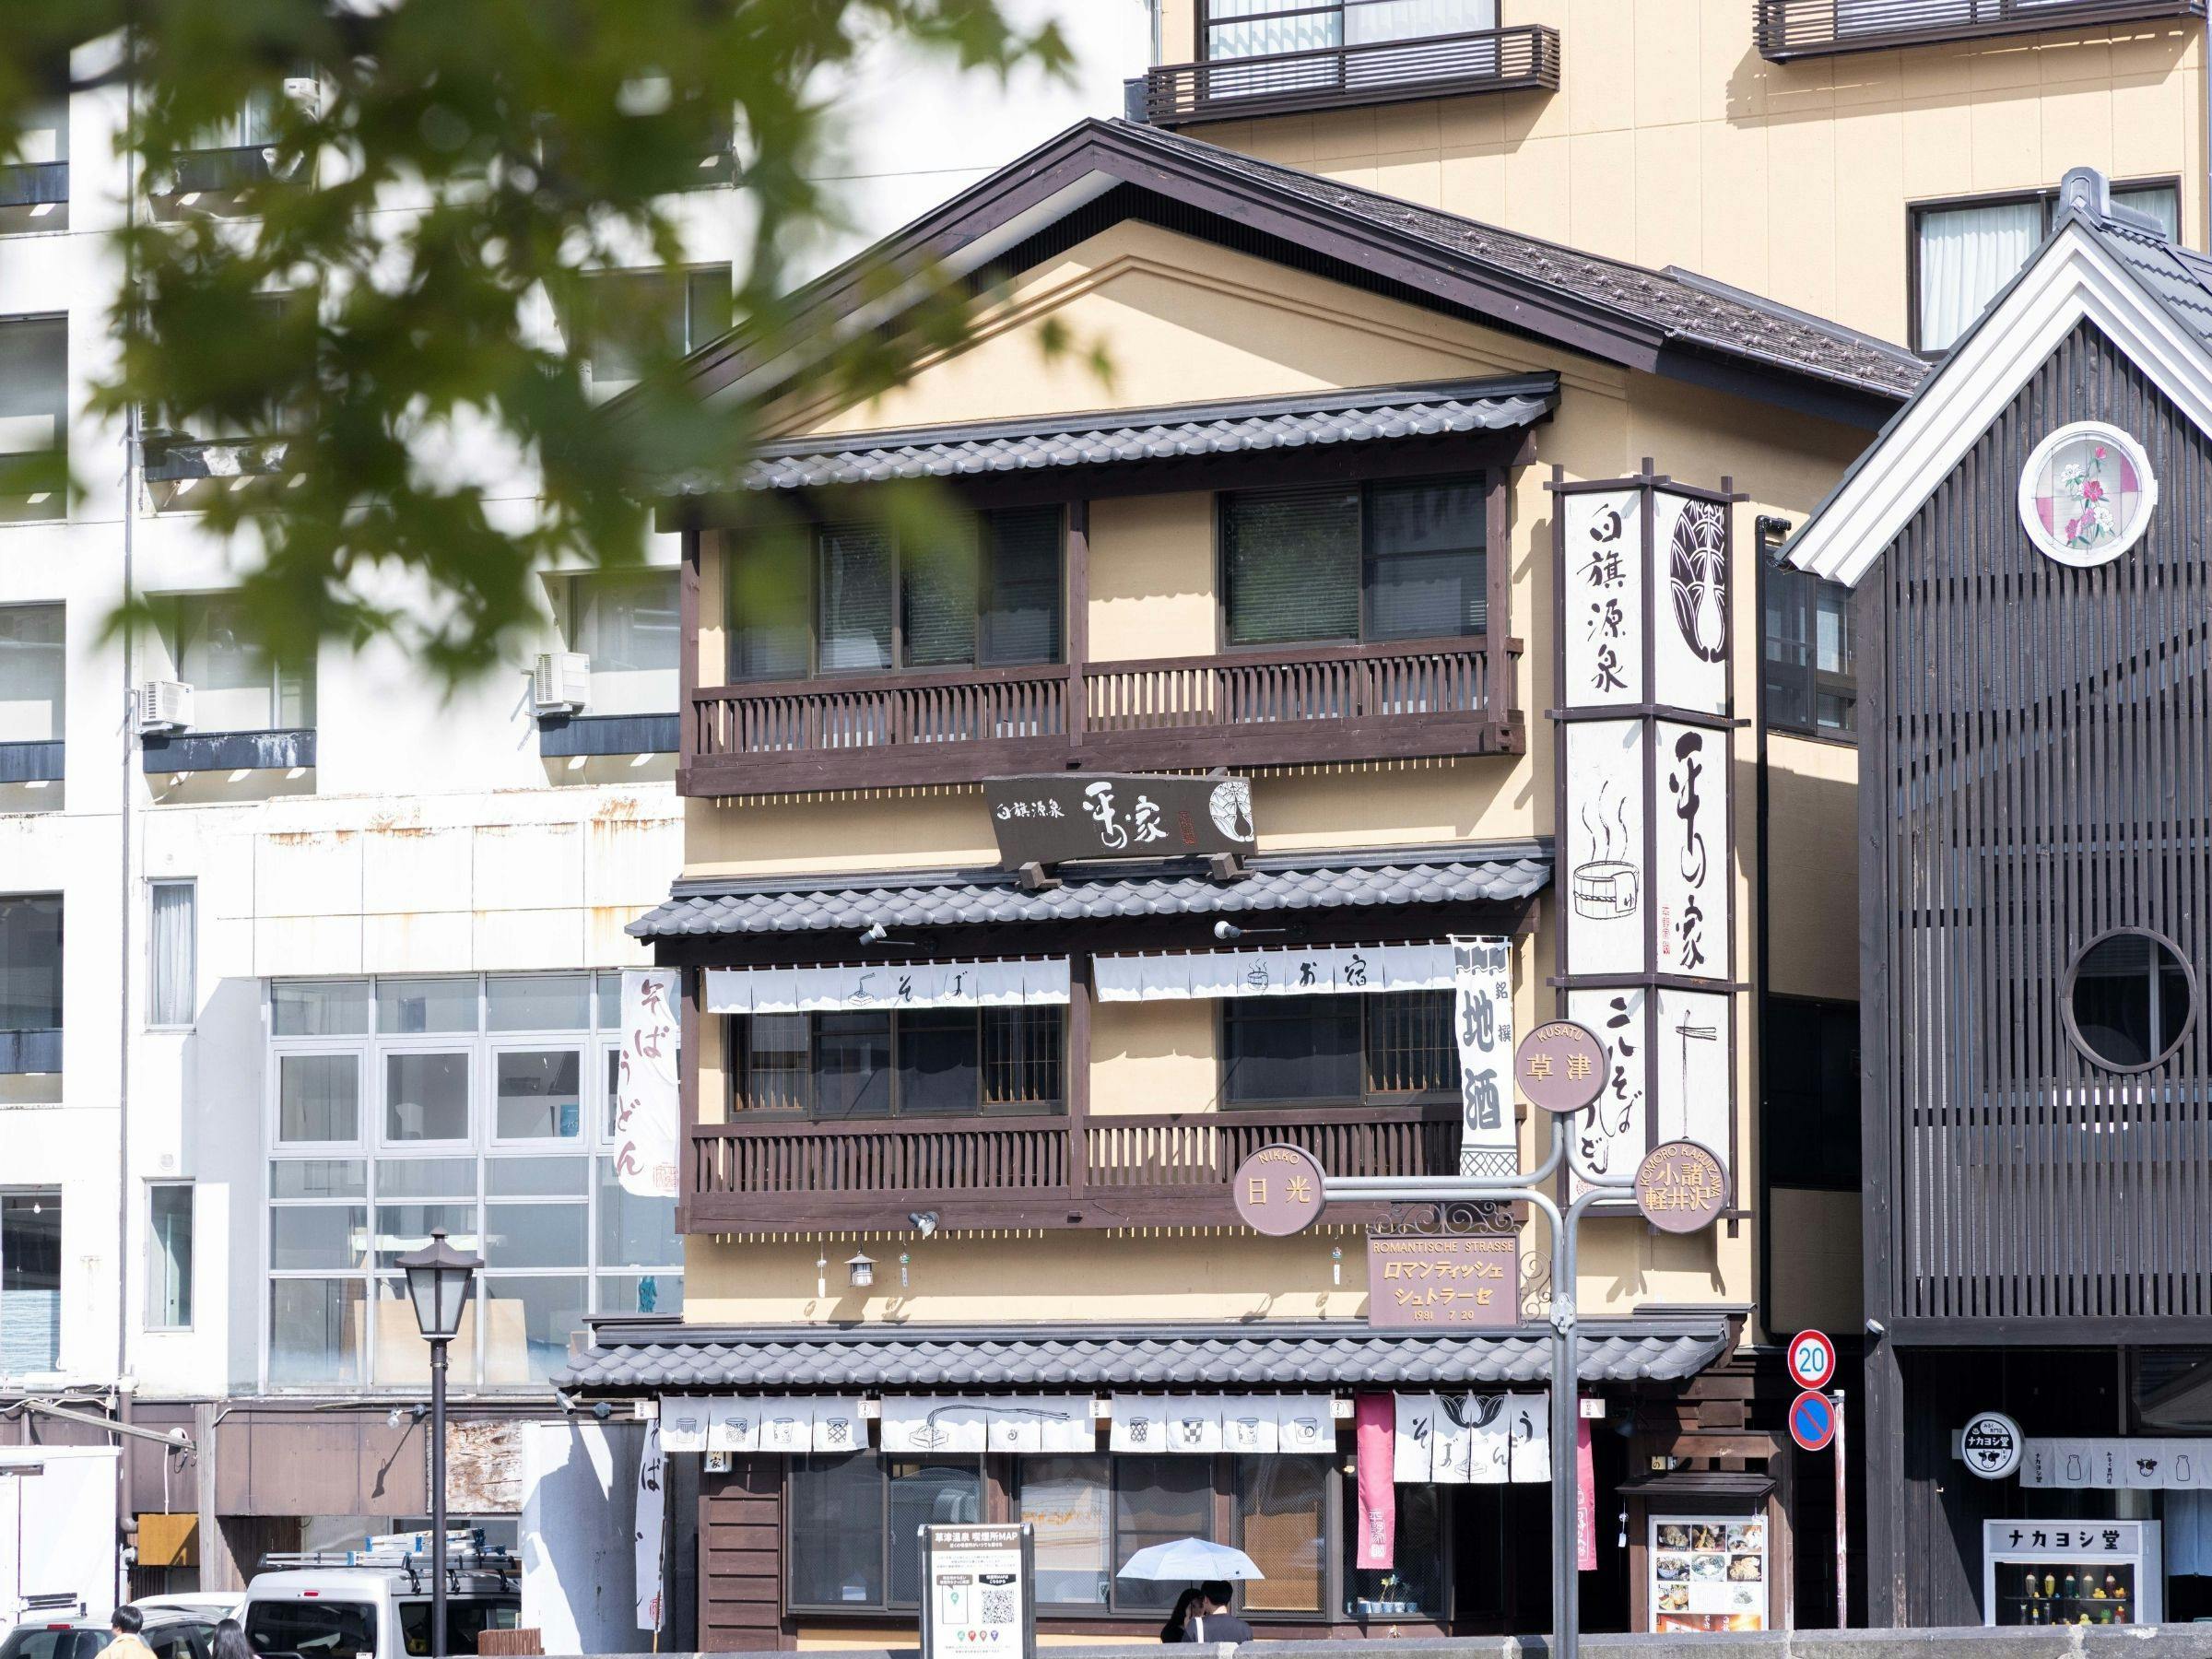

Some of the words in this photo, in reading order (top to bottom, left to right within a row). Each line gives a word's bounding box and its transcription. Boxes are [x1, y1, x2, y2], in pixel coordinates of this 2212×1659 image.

[1577, 504, 1628, 693] 白旗源泉
[997, 799, 1065, 820] 白旗源泉
[1300, 954, 1368, 987] お宿
[635, 979, 670, 1059] そば
[1536, 1026, 1583, 1042] KUSATU
[1463, 989, 1501, 1131] 地酒
[1526, 1053, 1592, 1081] 草津
[617, 1049, 644, 1176] うどん
[1258, 1149, 1300, 1165] NIKKO
[1640, 1146, 1677, 1187] KOMORO
[1681, 1145, 1721, 1198] KARUIZAWA
[1654, 1162, 1703, 1187] 小諸
[1248, 1175, 1312, 1206] 日光
[1645, 1186, 1711, 1212] 軽井沢
[1373, 1241, 1458, 1253] ROMANTISCHE
[1465, 1241, 1514, 1253] STRASSE
[1383, 1260, 1504, 1280] ロマンティッシェ
[1461, 1310, 1475, 1321] 20
[1799, 1347, 1825, 1372] 20
[1968, 1436, 2010, 1447] ナカヨシ堂
[2008, 1529, 2120, 1550] ナカヨシ堂
